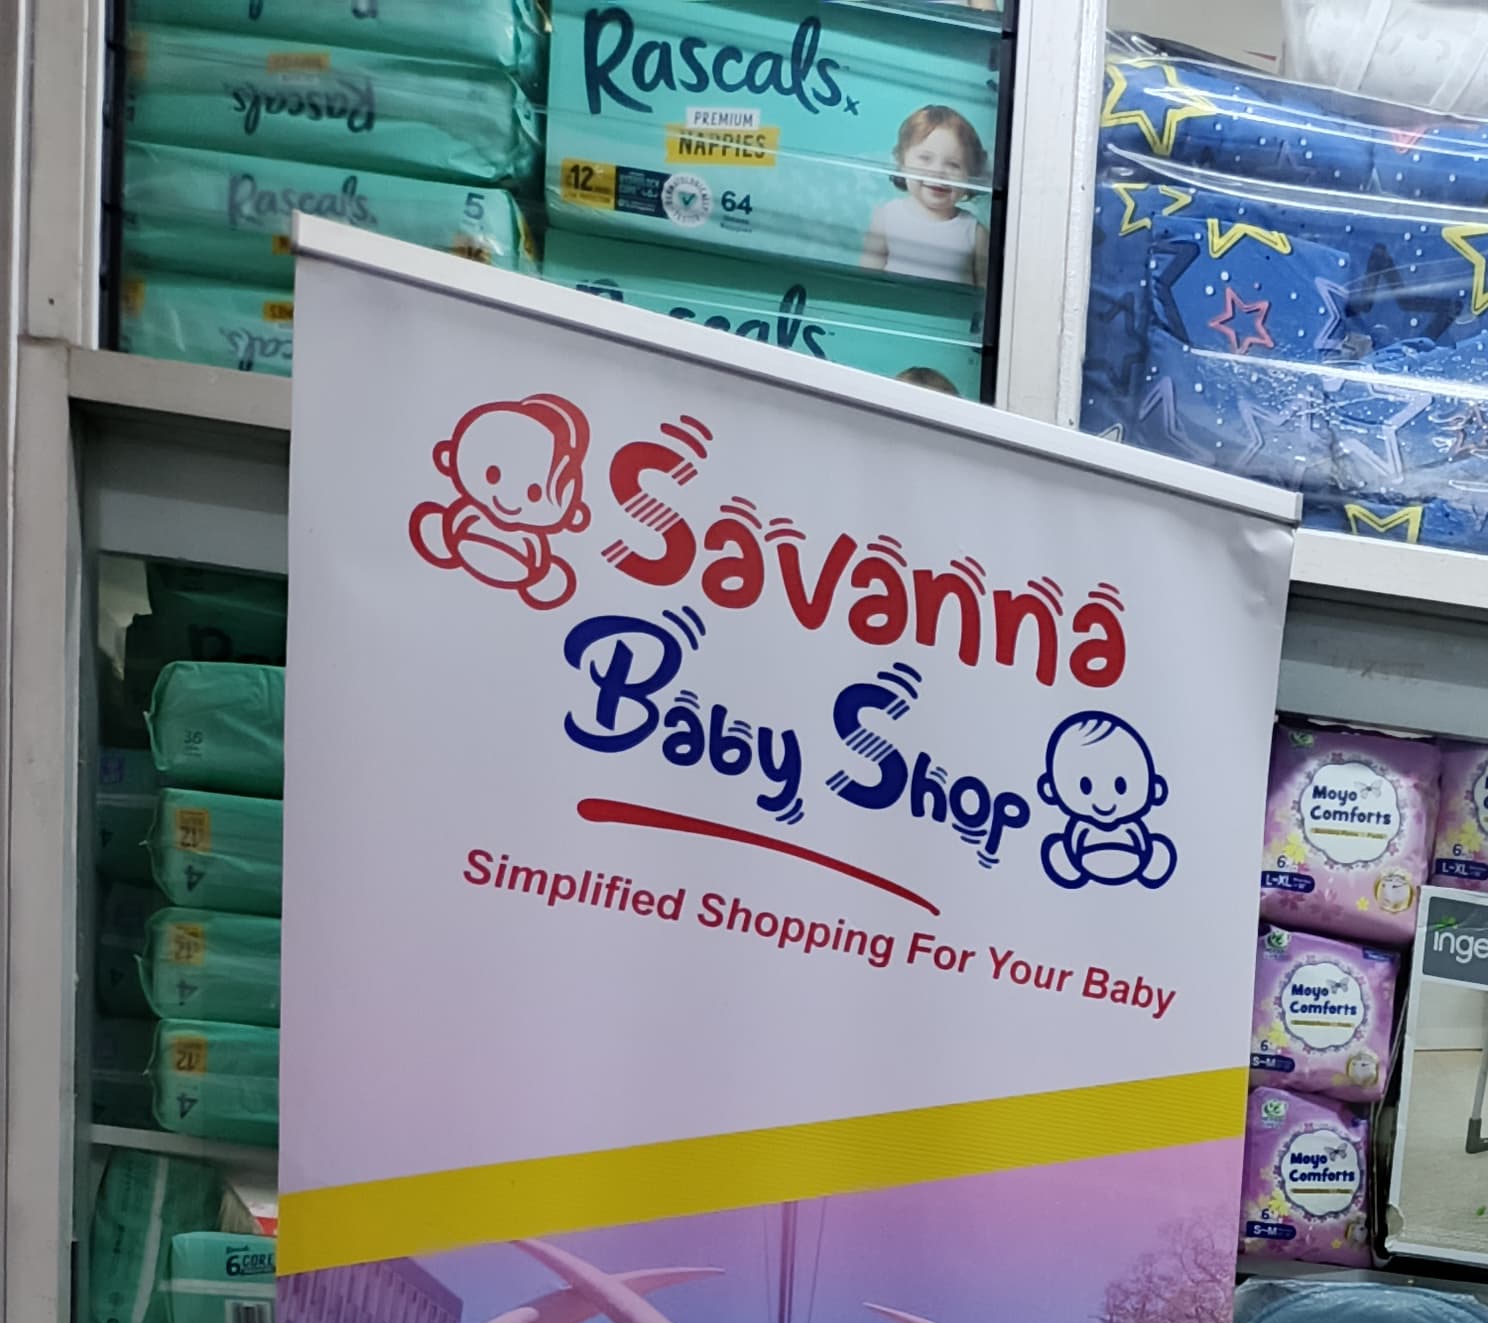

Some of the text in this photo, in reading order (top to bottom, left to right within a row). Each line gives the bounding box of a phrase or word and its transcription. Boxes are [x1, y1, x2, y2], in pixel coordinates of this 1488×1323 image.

[584, 8, 842, 115] Rascals
[232, 79, 375, 134] Rascals
[694, 110, 754, 128] PREMIUM
[678, 130, 767, 159] NAPPIES
[569, 164, 594, 192] 12
[228, 173, 371, 229] Rascals
[464, 192, 485, 221] 5
[720, 190, 753, 215] 64
[602, 438, 1127, 688] Savanna
[564, 614, 1031, 858] Baby Shop
[1312, 785, 1358, 806] Moyo
[1310, 805, 1392, 825] Comforts
[1452, 844, 1462, 856] 6
[1277, 855, 1286, 868] 6
[462, 847, 1178, 1021] Simplified Shopping For Your Baby
[1291, 984, 1329, 1001] Moyo
[1290, 1001, 1357, 1015] Comforts
[1260, 1040, 1268, 1051] 6
[1290, 1152, 1328, 1170] Moyo
[1289, 1168, 1355, 1183] Comforts
[1261, 1208, 1269, 1219] 6
